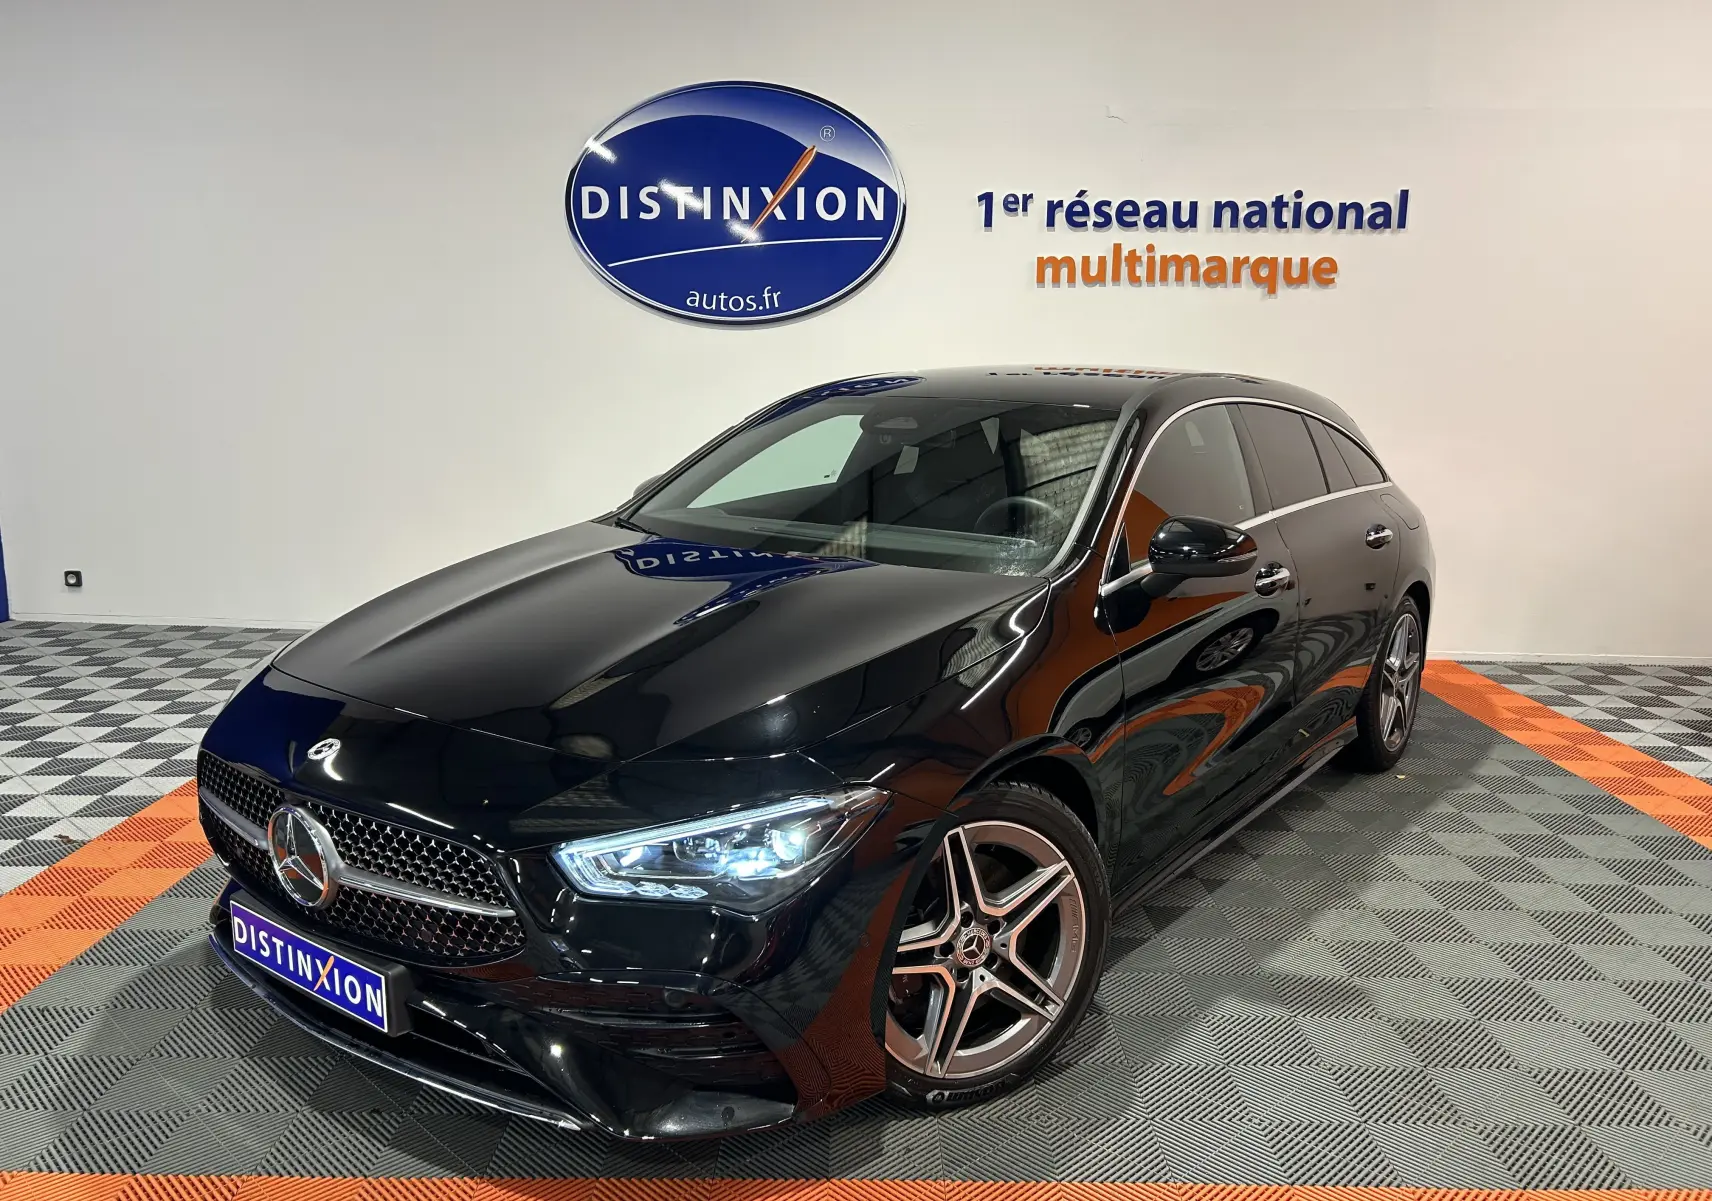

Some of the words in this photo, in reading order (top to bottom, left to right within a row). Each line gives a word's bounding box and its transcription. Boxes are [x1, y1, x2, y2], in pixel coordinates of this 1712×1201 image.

[581, 185, 884, 222] DISTINXION
[1045, 189, 1198, 229] réseau
[1212, 189, 1410, 230] national
[1035, 243, 1338, 295] multimarque
[685, 286, 782, 312] autos.fr
[233, 916, 383, 1018] DISTINXION
